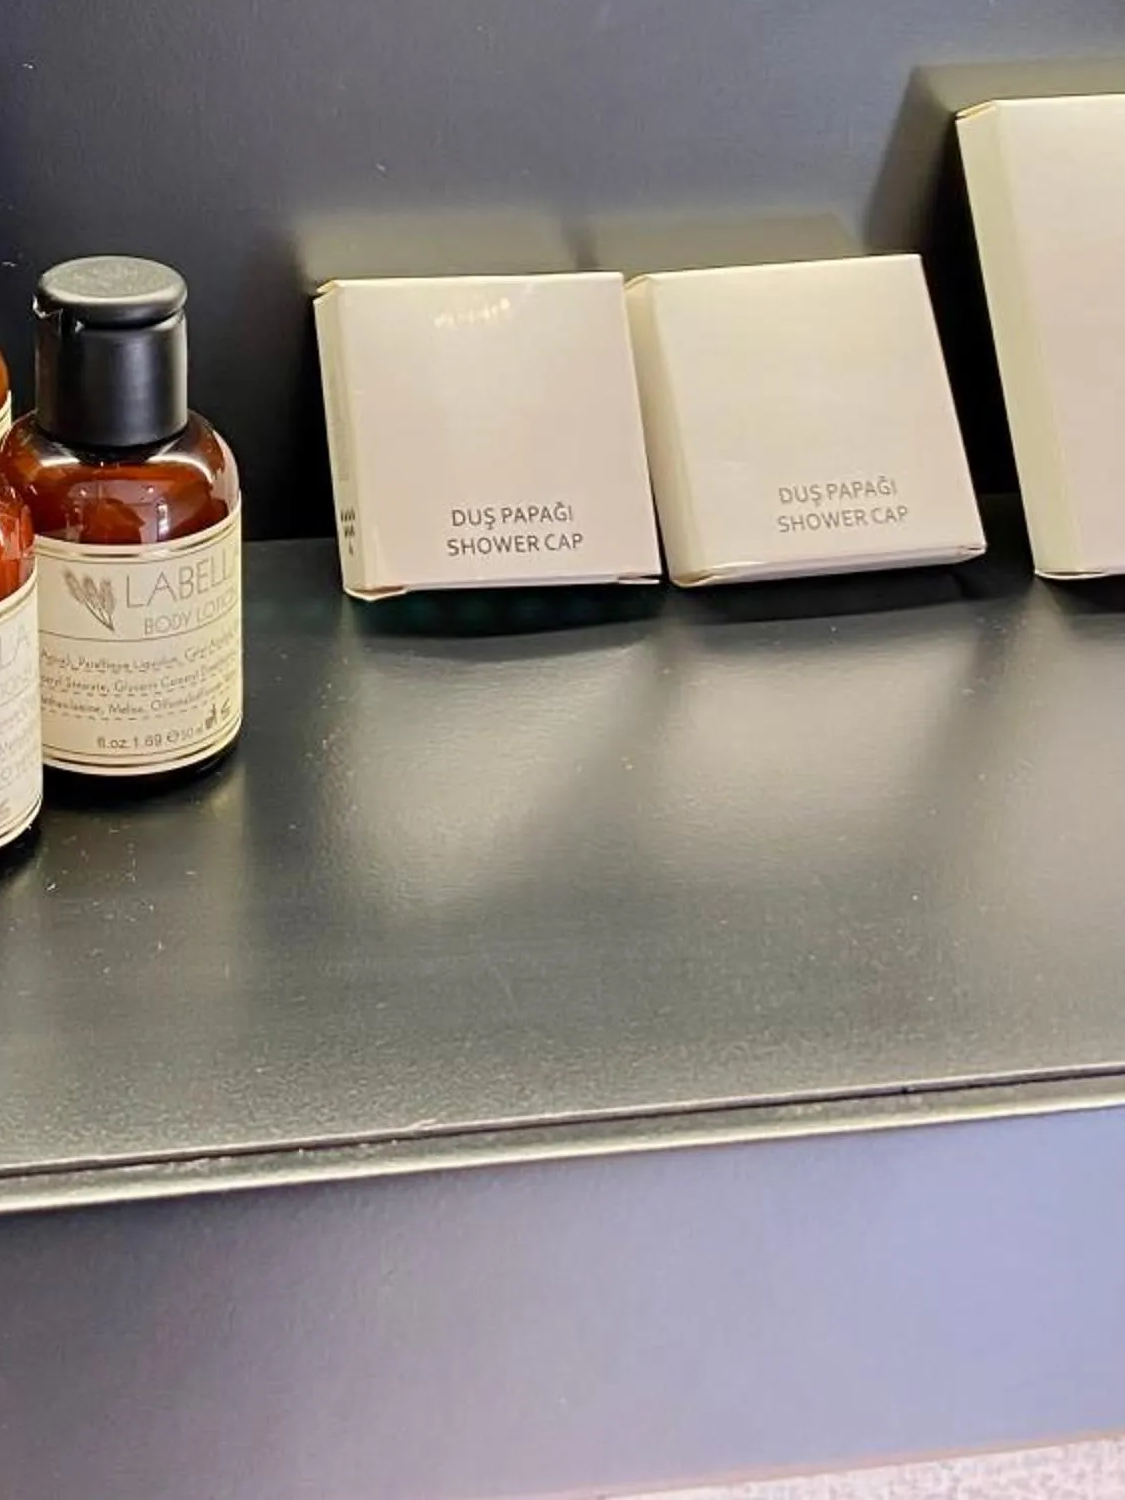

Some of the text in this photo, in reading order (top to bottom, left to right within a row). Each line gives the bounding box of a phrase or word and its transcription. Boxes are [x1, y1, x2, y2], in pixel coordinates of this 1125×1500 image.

[778, 475, 897, 507] DUŞ PAPAĞI
[451, 501, 573, 530] DUŞ PAPAĞI
[777, 504, 908, 532] SHOWER CAP
[446, 533, 583, 556] SHOWER CAP
[144, 611, 192, 636] BODY
